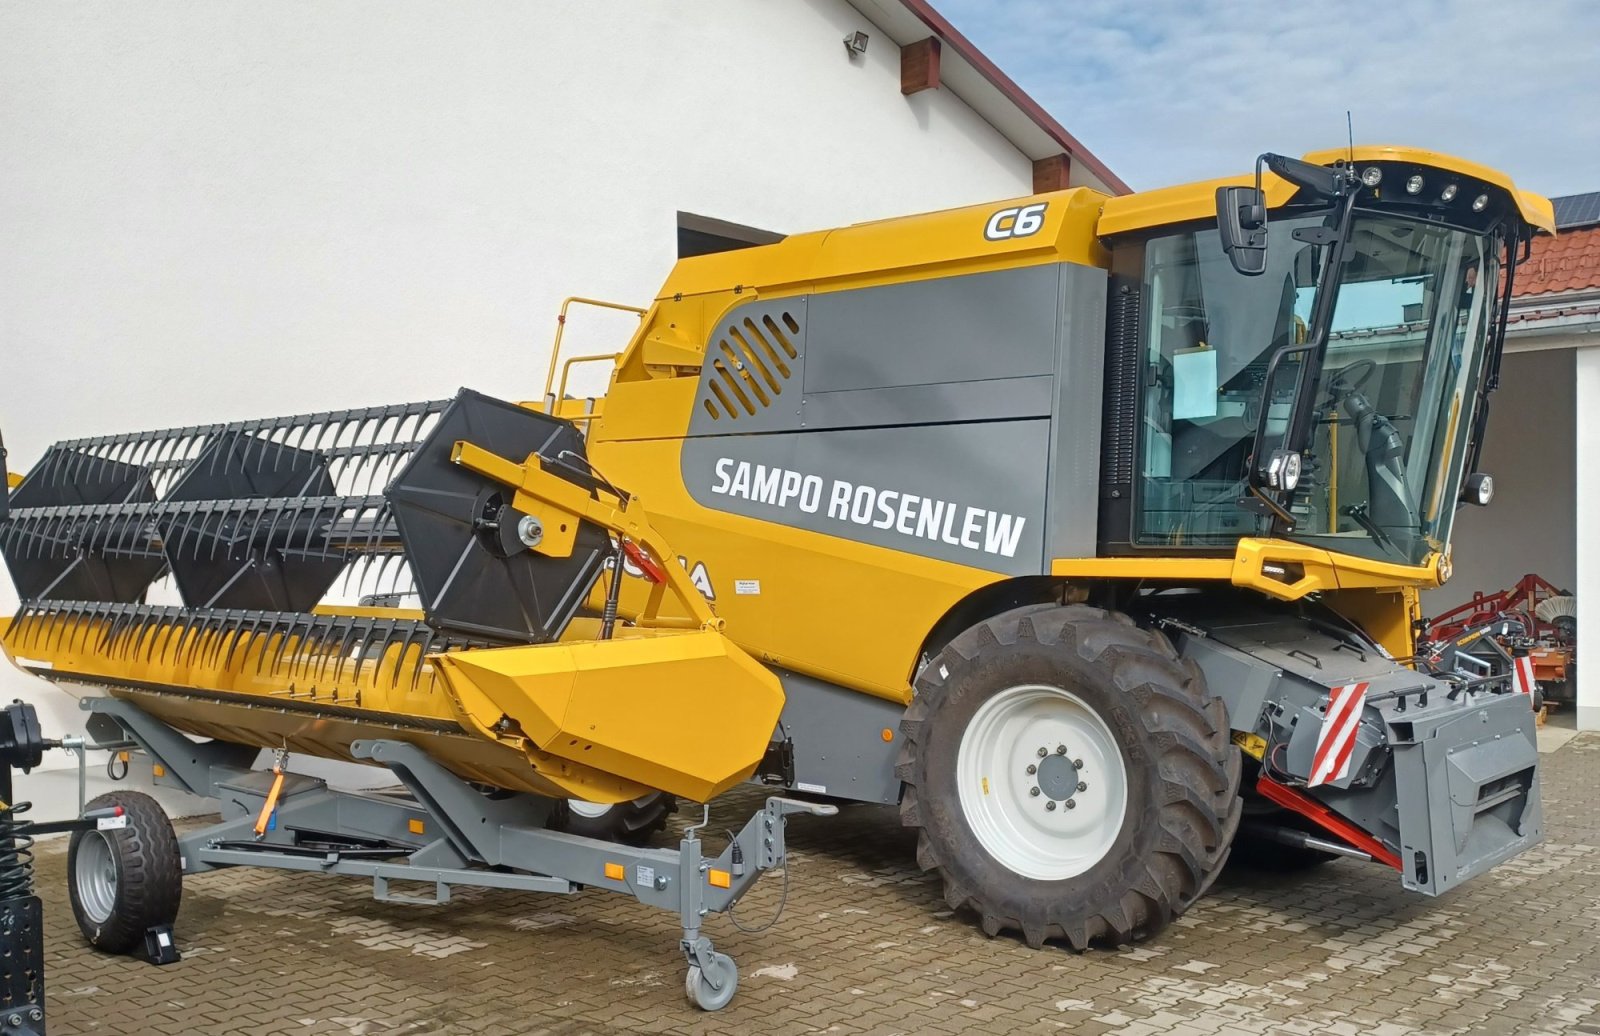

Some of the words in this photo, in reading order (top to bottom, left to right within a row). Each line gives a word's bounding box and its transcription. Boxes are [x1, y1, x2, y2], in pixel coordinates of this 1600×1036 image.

[985, 202, 1048, 240] C6
[711, 457, 823, 514] SAMPO
[827, 479, 1026, 558] ROSENLEW
